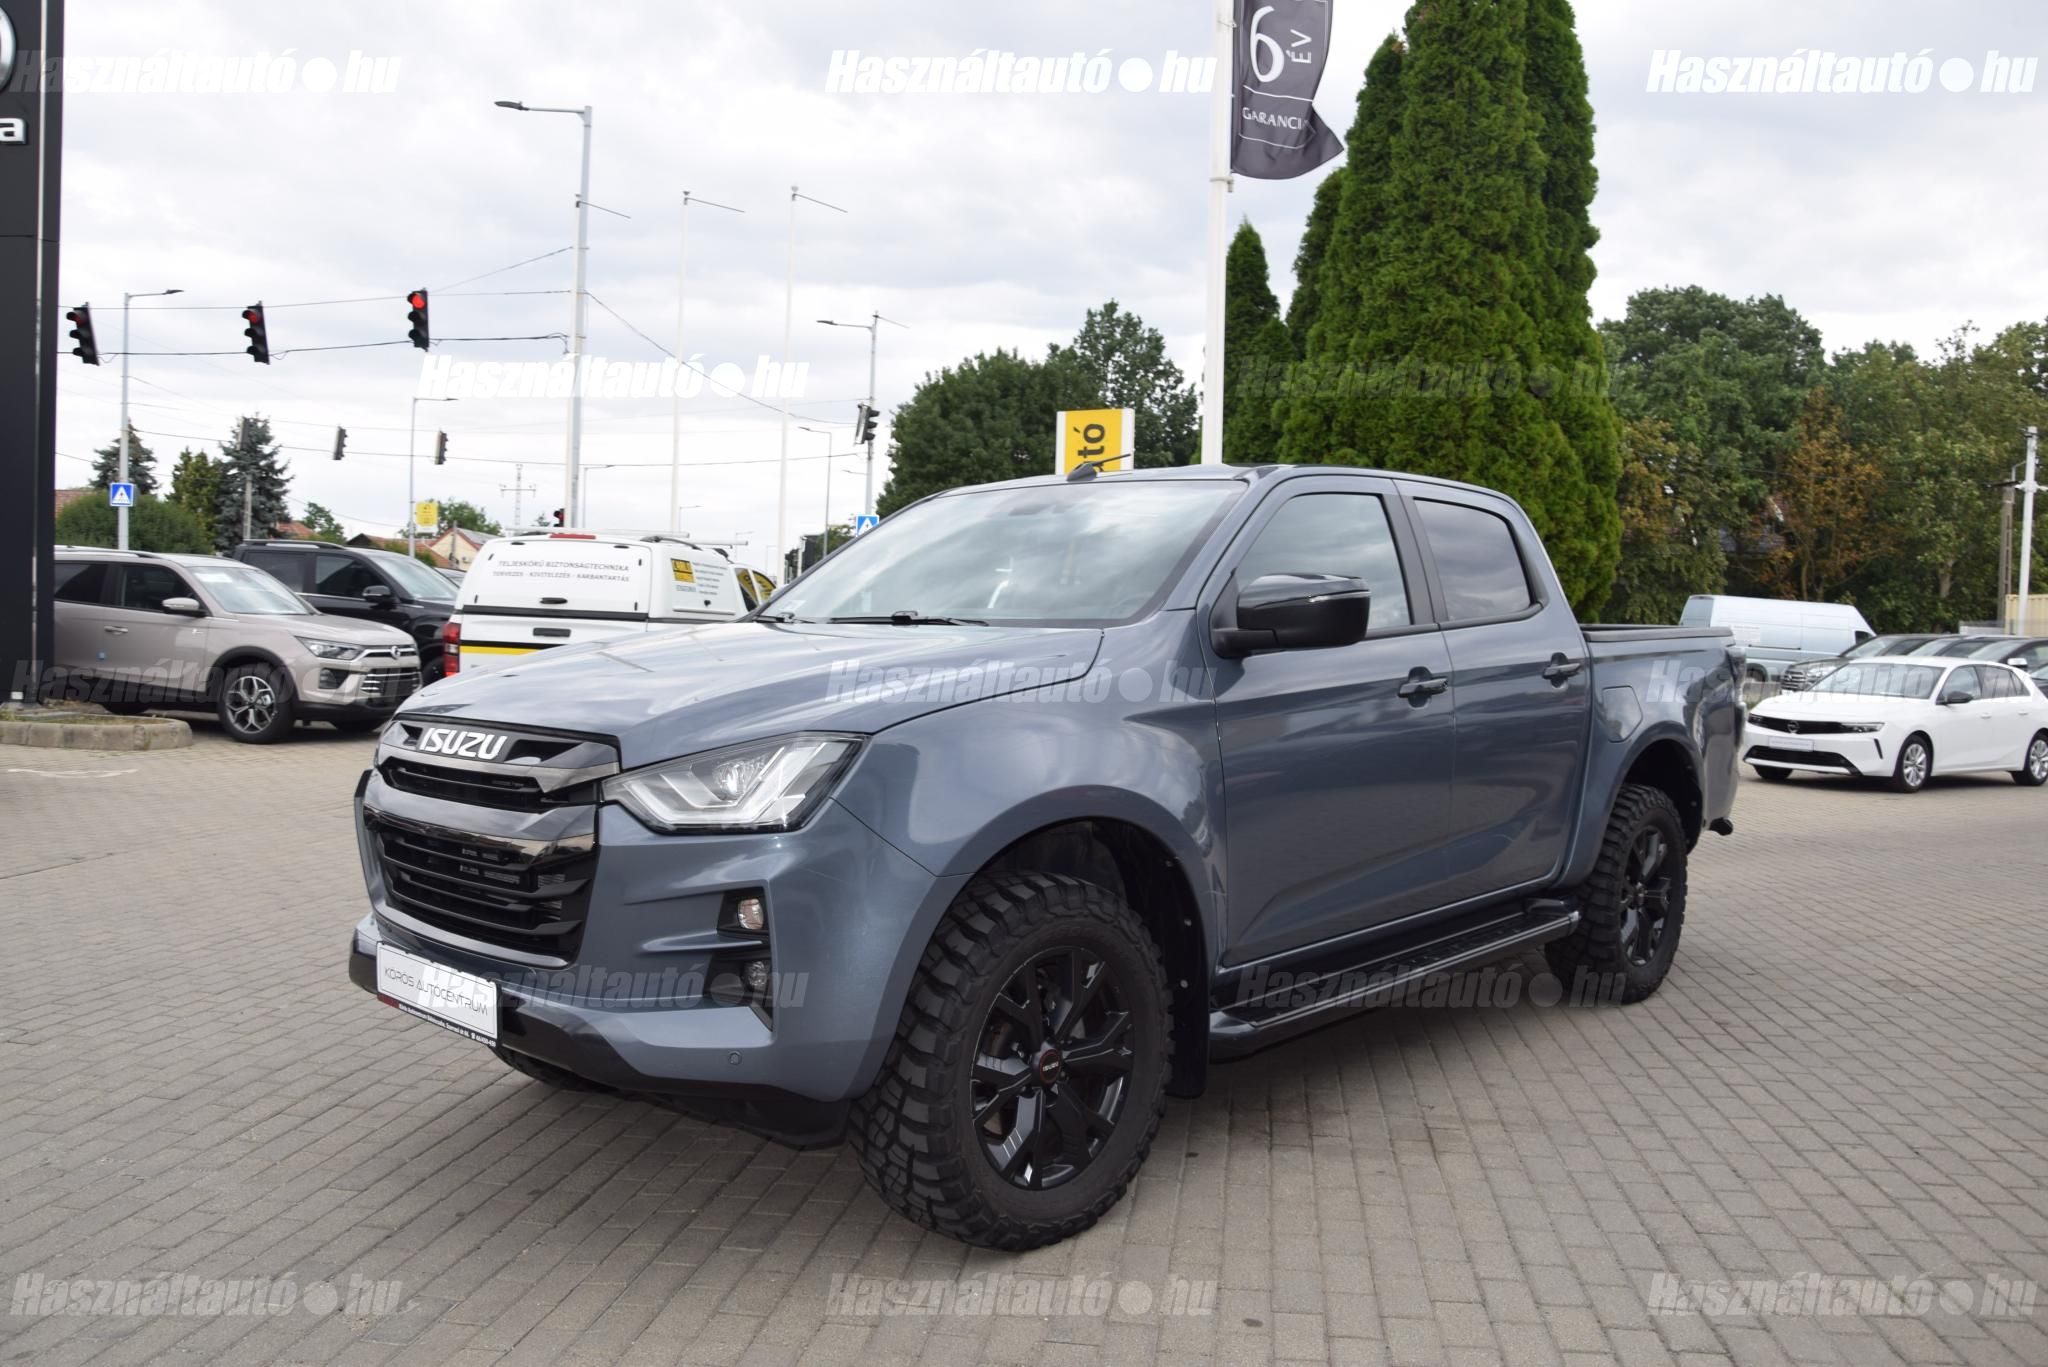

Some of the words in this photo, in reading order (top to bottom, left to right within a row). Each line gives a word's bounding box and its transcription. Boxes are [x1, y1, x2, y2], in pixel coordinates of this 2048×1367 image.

[1250, 5, 1285, 82] 6
[1286, 28, 1312, 64] ÉV
[419, 727, 508, 760] ISUZU
